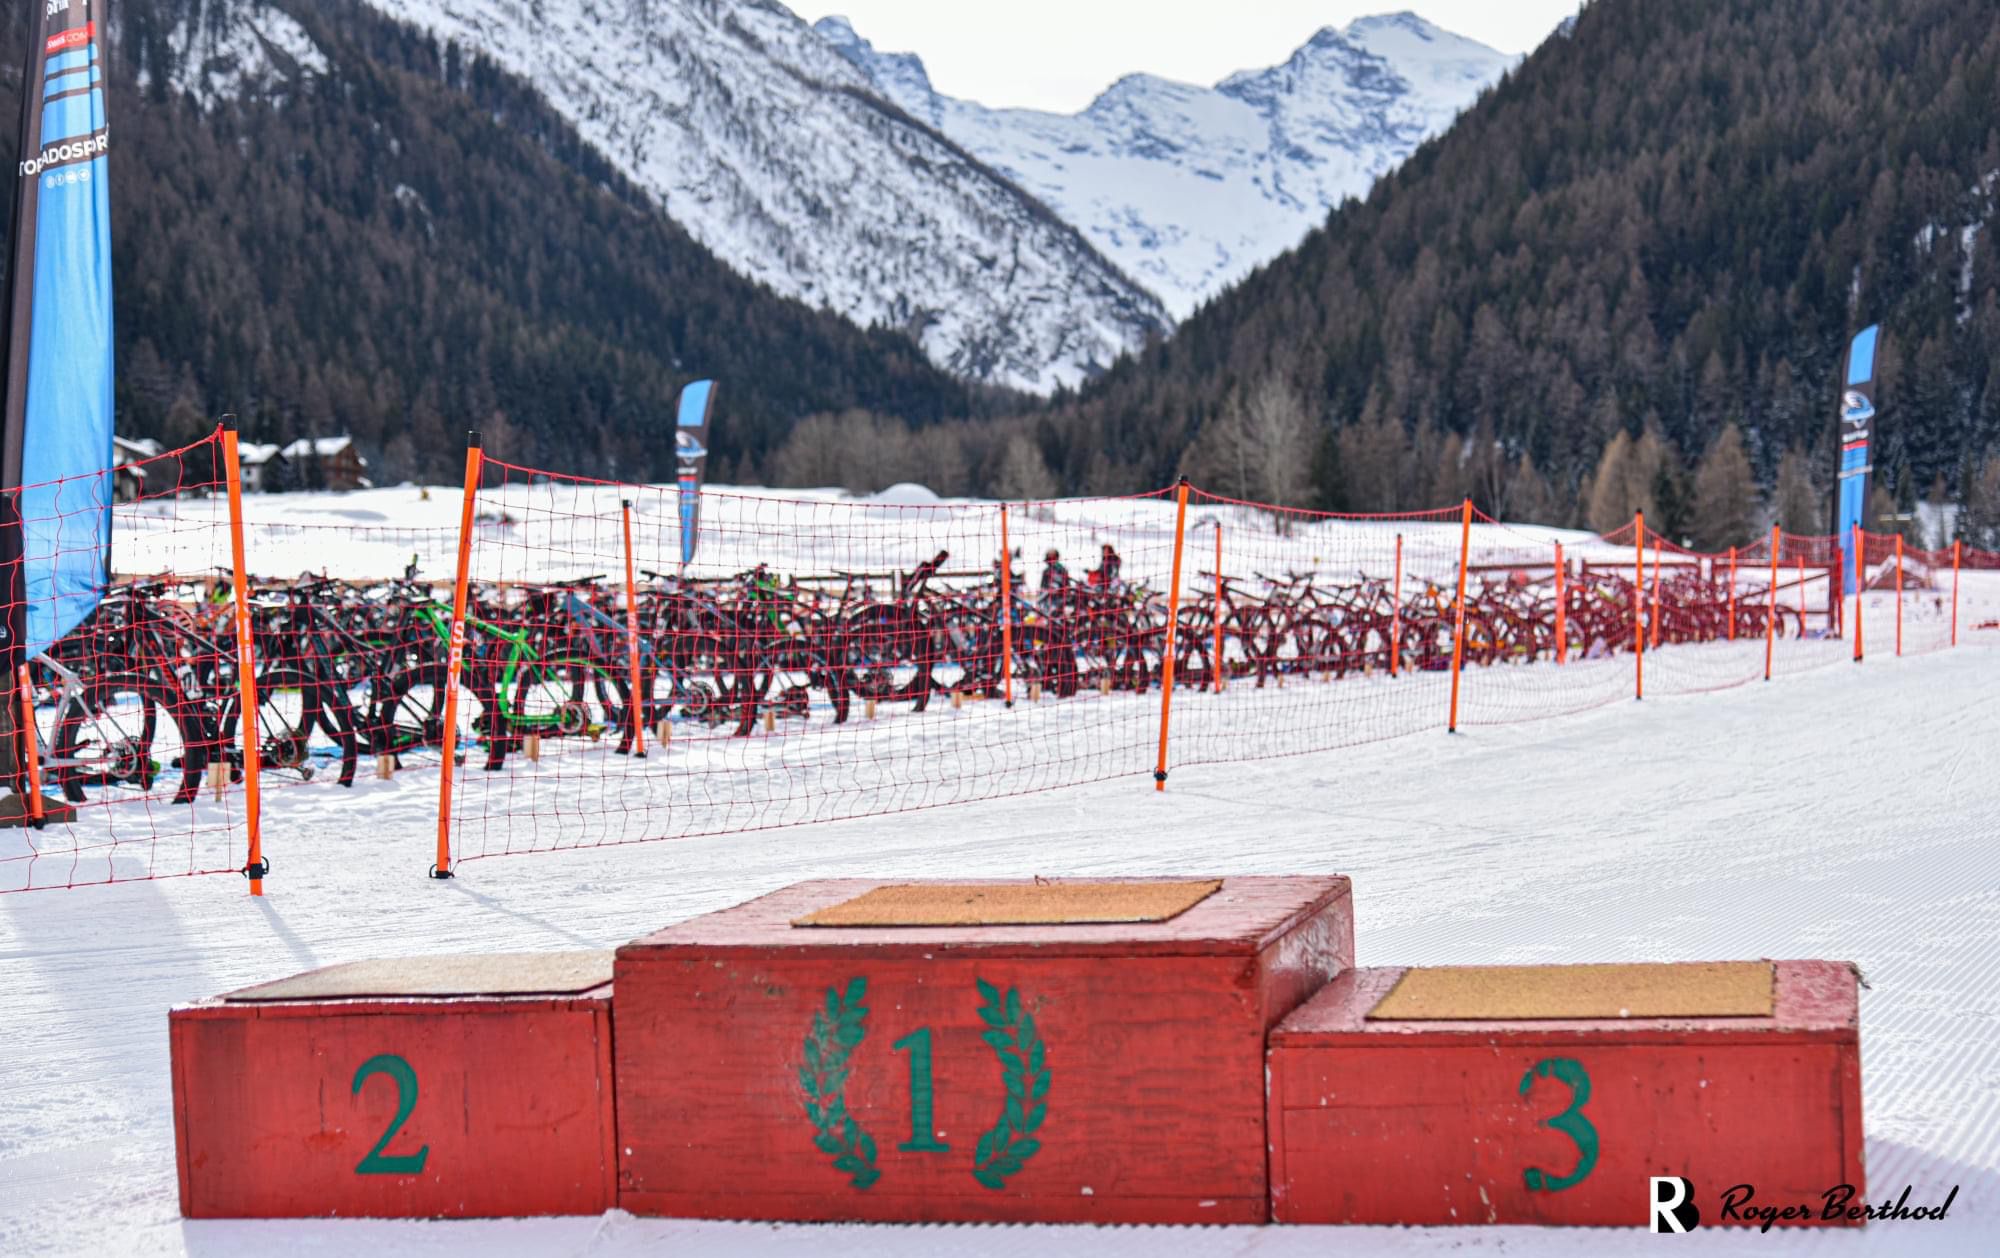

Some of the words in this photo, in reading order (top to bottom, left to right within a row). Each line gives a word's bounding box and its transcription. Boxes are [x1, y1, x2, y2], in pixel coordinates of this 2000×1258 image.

[351, 1053, 430, 1175] 2
[891, 1025, 950, 1153] 1
[1519, 1057, 1599, 1192] 3
